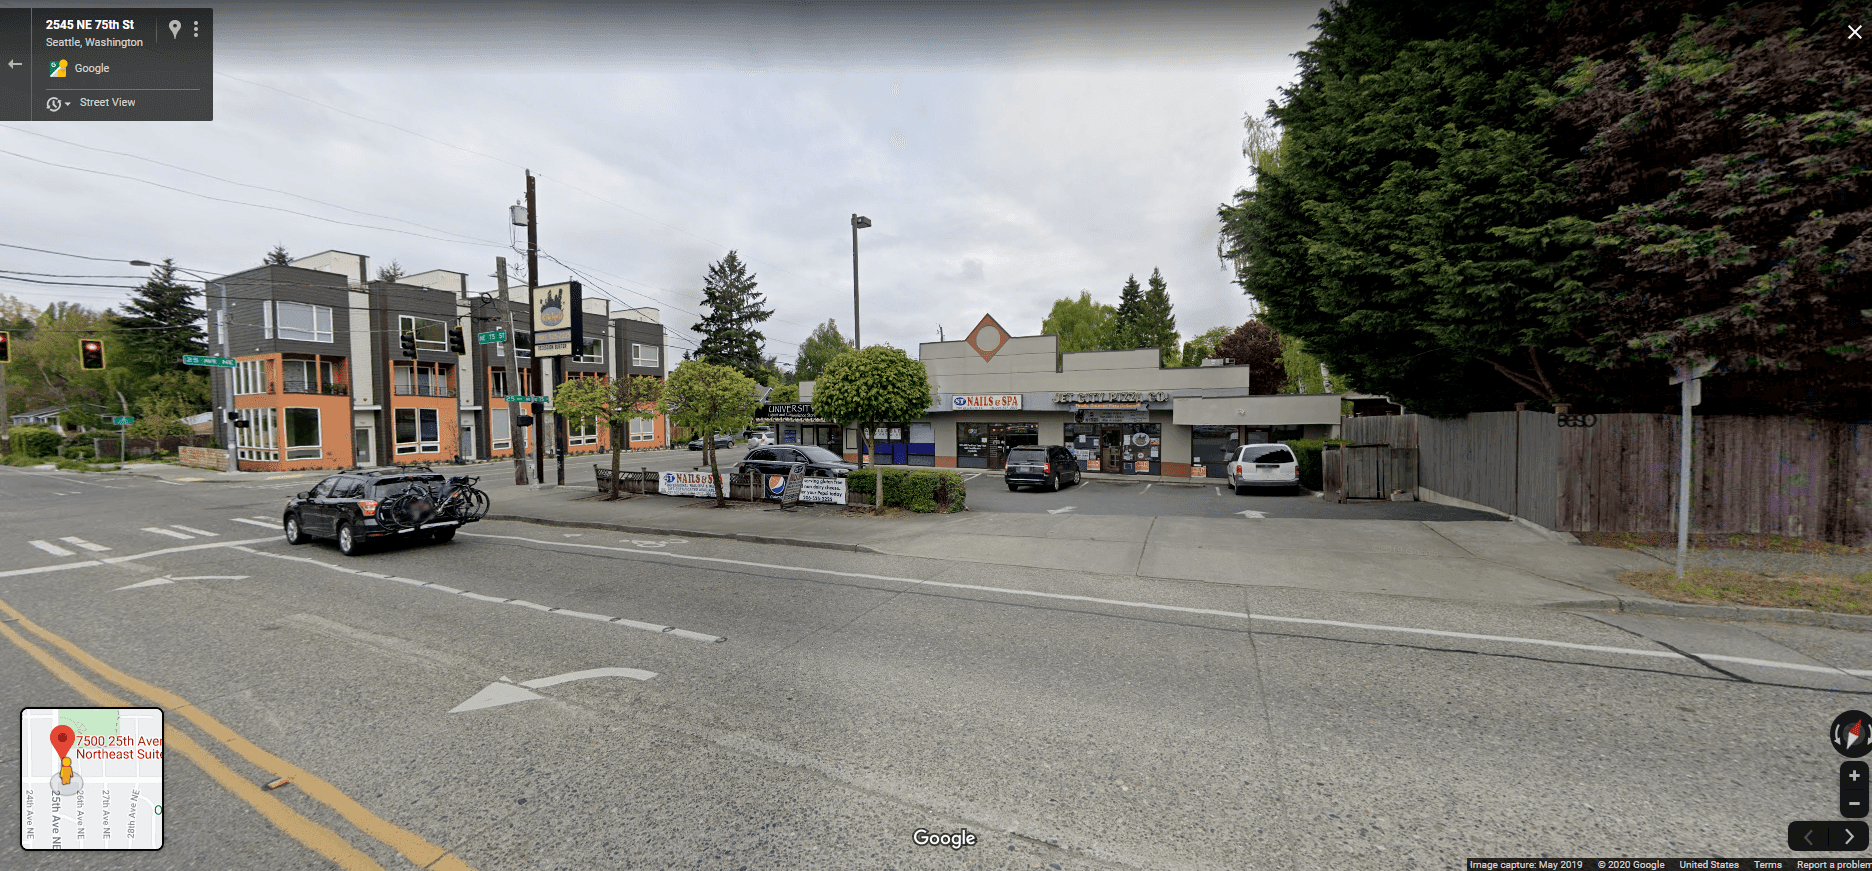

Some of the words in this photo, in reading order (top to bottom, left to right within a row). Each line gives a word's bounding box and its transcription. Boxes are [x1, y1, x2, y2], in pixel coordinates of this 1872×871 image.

[967, 396, 993, 406] NAILS
[1002, 395, 1018, 406] SPA
[1052, 392, 1074, 403] JET
[1077, 392, 1105, 403] CITY
[1108, 391, 1143, 403] PIZZA
[676, 474, 700, 483] NAILS
